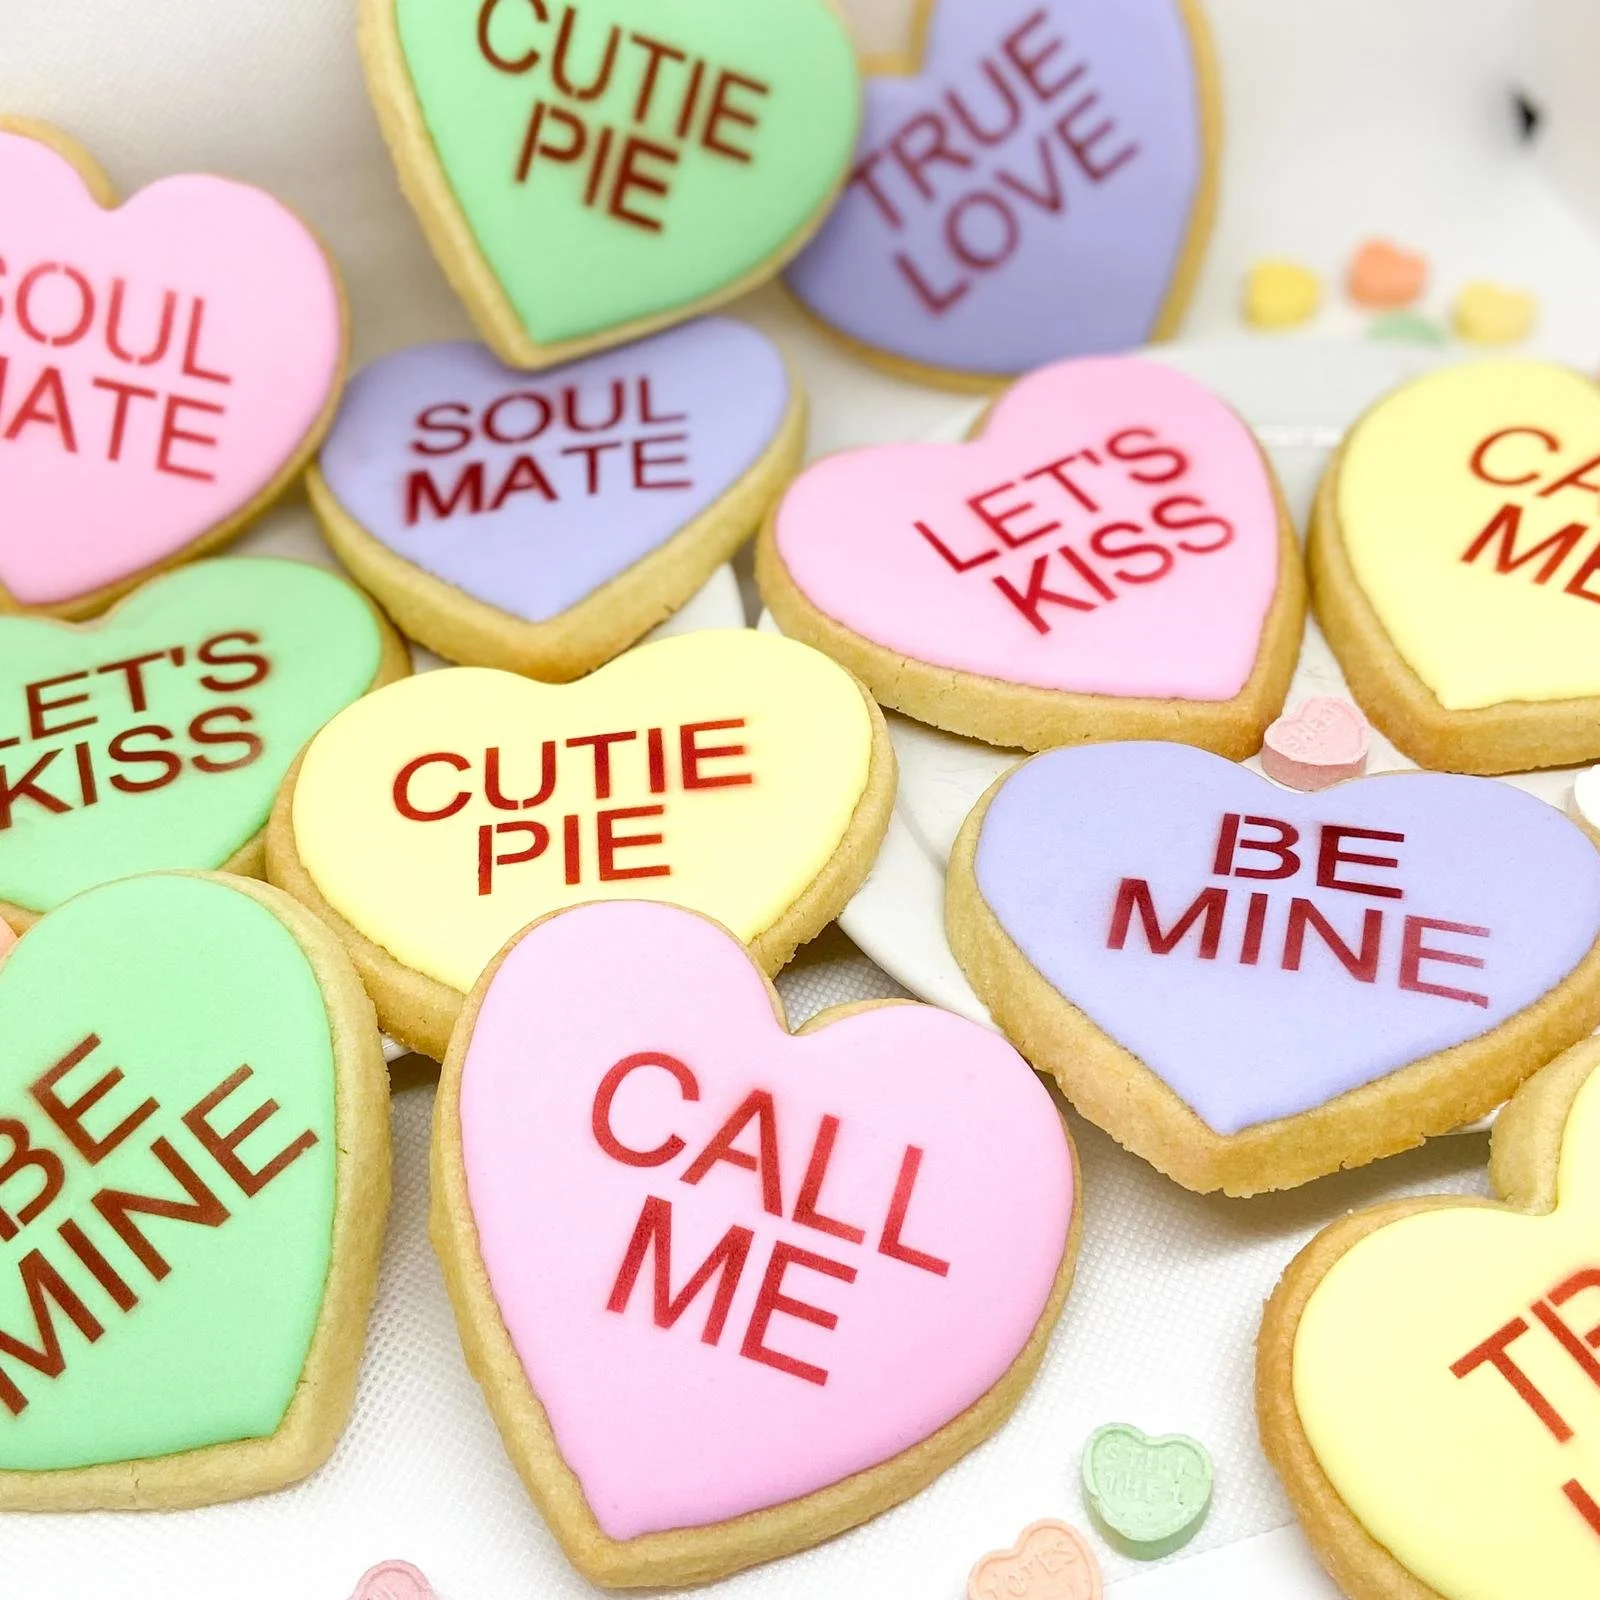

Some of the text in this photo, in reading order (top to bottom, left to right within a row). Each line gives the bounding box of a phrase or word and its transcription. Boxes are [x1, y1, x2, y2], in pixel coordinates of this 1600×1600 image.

[476, 0, 770, 164] CUTIE
[850, 10, 1085, 232] TRUE
[514, 101, 680, 233] PIE
[892, 92, 1137, 319] LOVE
[0, 257, 233, 385] OUL
[0, 355, 226, 482] ATE
[404, 434, 692, 525] MATE
[409, 377, 687, 457] SOUL
[914, 428, 1190, 573] LET'S
[992, 495, 1234, 635] KISS
[0, 631, 271, 749] ET'S
[0, 706, 264, 831] KISS
[393, 718, 754, 822] CUTIE
[478, 805, 670, 896] PIE
[1213, 813, 1405, 899] BE
[1107, 878, 1490, 1009] MINE
[592, 1051, 950, 1277] CALL
[0, 1064, 319, 1416] MINE
[606, 1195, 858, 1386] ME
